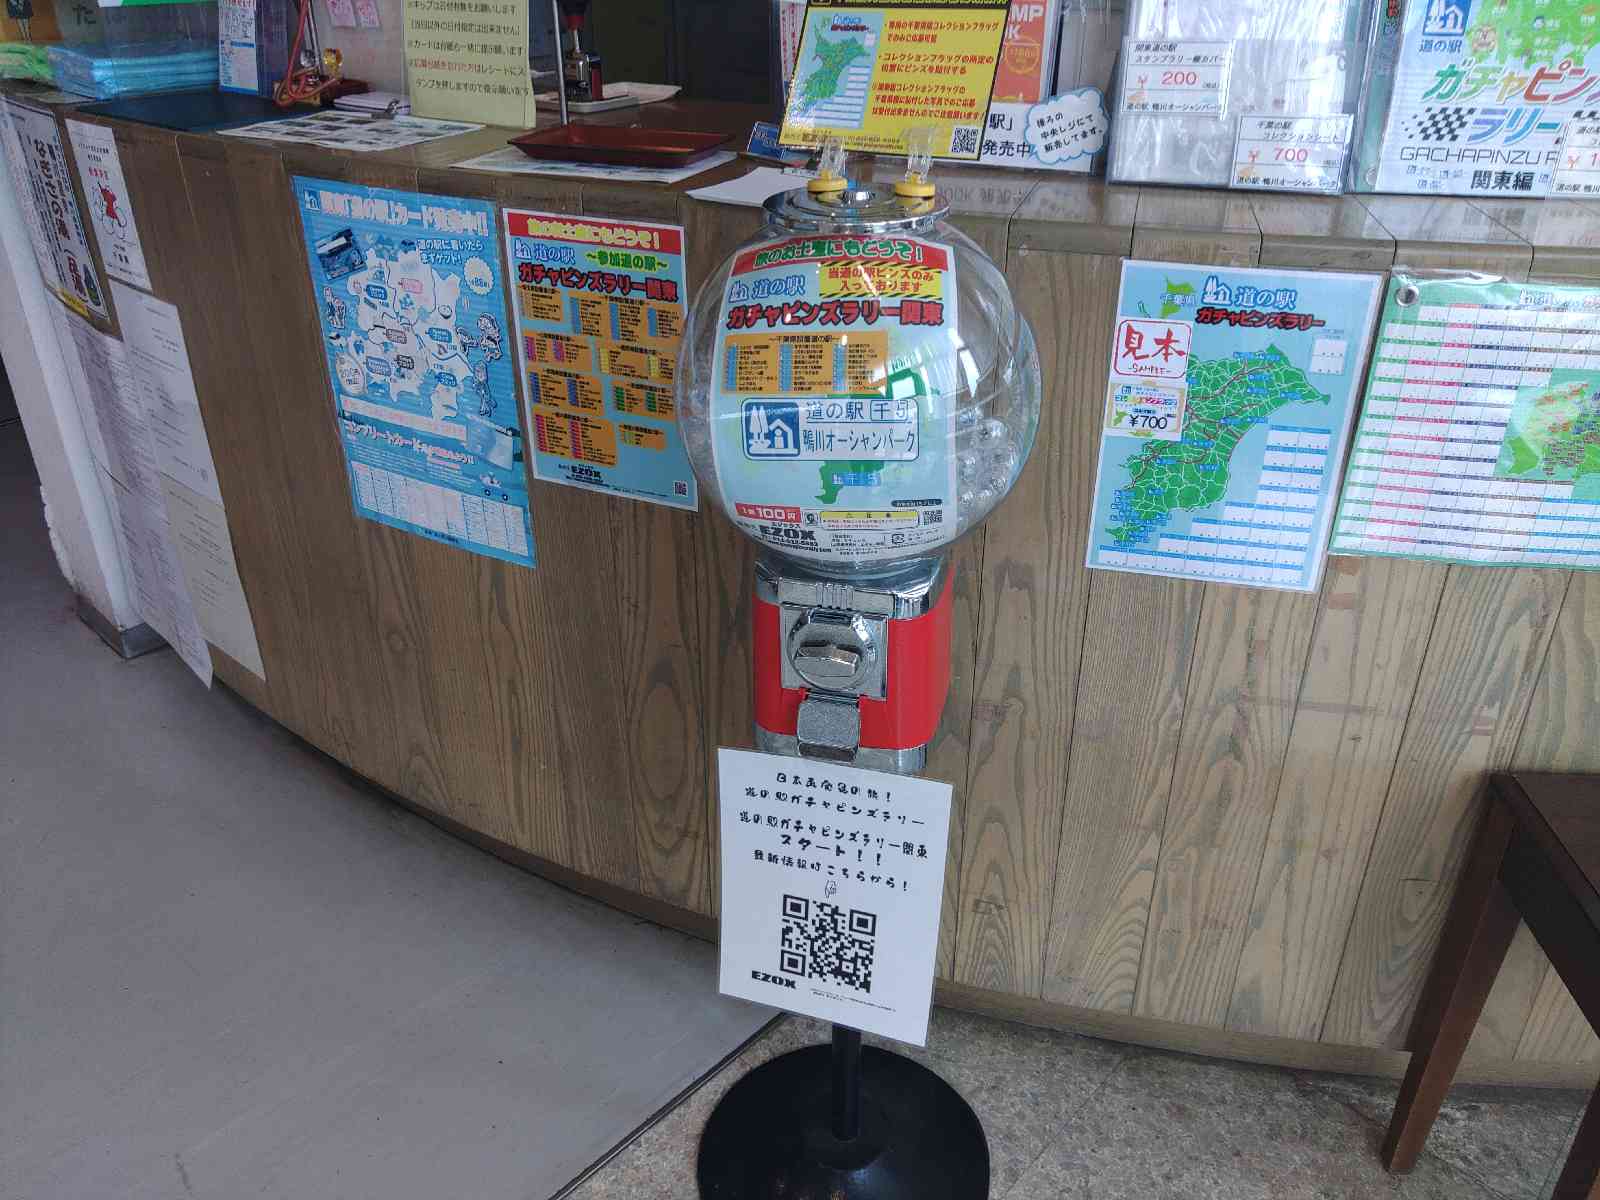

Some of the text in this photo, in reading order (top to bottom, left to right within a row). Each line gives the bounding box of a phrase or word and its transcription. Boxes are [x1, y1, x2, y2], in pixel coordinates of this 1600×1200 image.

[1418, 39, 1463, 53] 道の駅
[1161, 71, 1198, 87] 200
[1423, 57, 1600, 105] ガチャピン
[1467, 106, 1562, 145] ラリー
[982, 140, 1032, 158] 発売中
[1274, 146, 1310, 163] 700
[1400, 146, 1542, 165] GACHAPINZU
[1470, 169, 1536, 191] 関東編
[532, 243, 577, 265] 道の駅
[751, 275, 806, 298] 道の駅
[1235, 285, 1298, 311] 道の駅
[725, 299, 945, 329] ガチャピンズラリー関東
[1196, 307, 1327, 331] ガチャピンズラリー
[1122, 322, 1187, 363] 見本
[806, 400, 865, 420] 道の駅
[1129, 414, 1168, 430] ¥700
[802, 428, 915, 452] 鴨川オーシャンパーク
[759, 525, 817, 541] EZOX
[751, 969, 797, 989] EZOX
